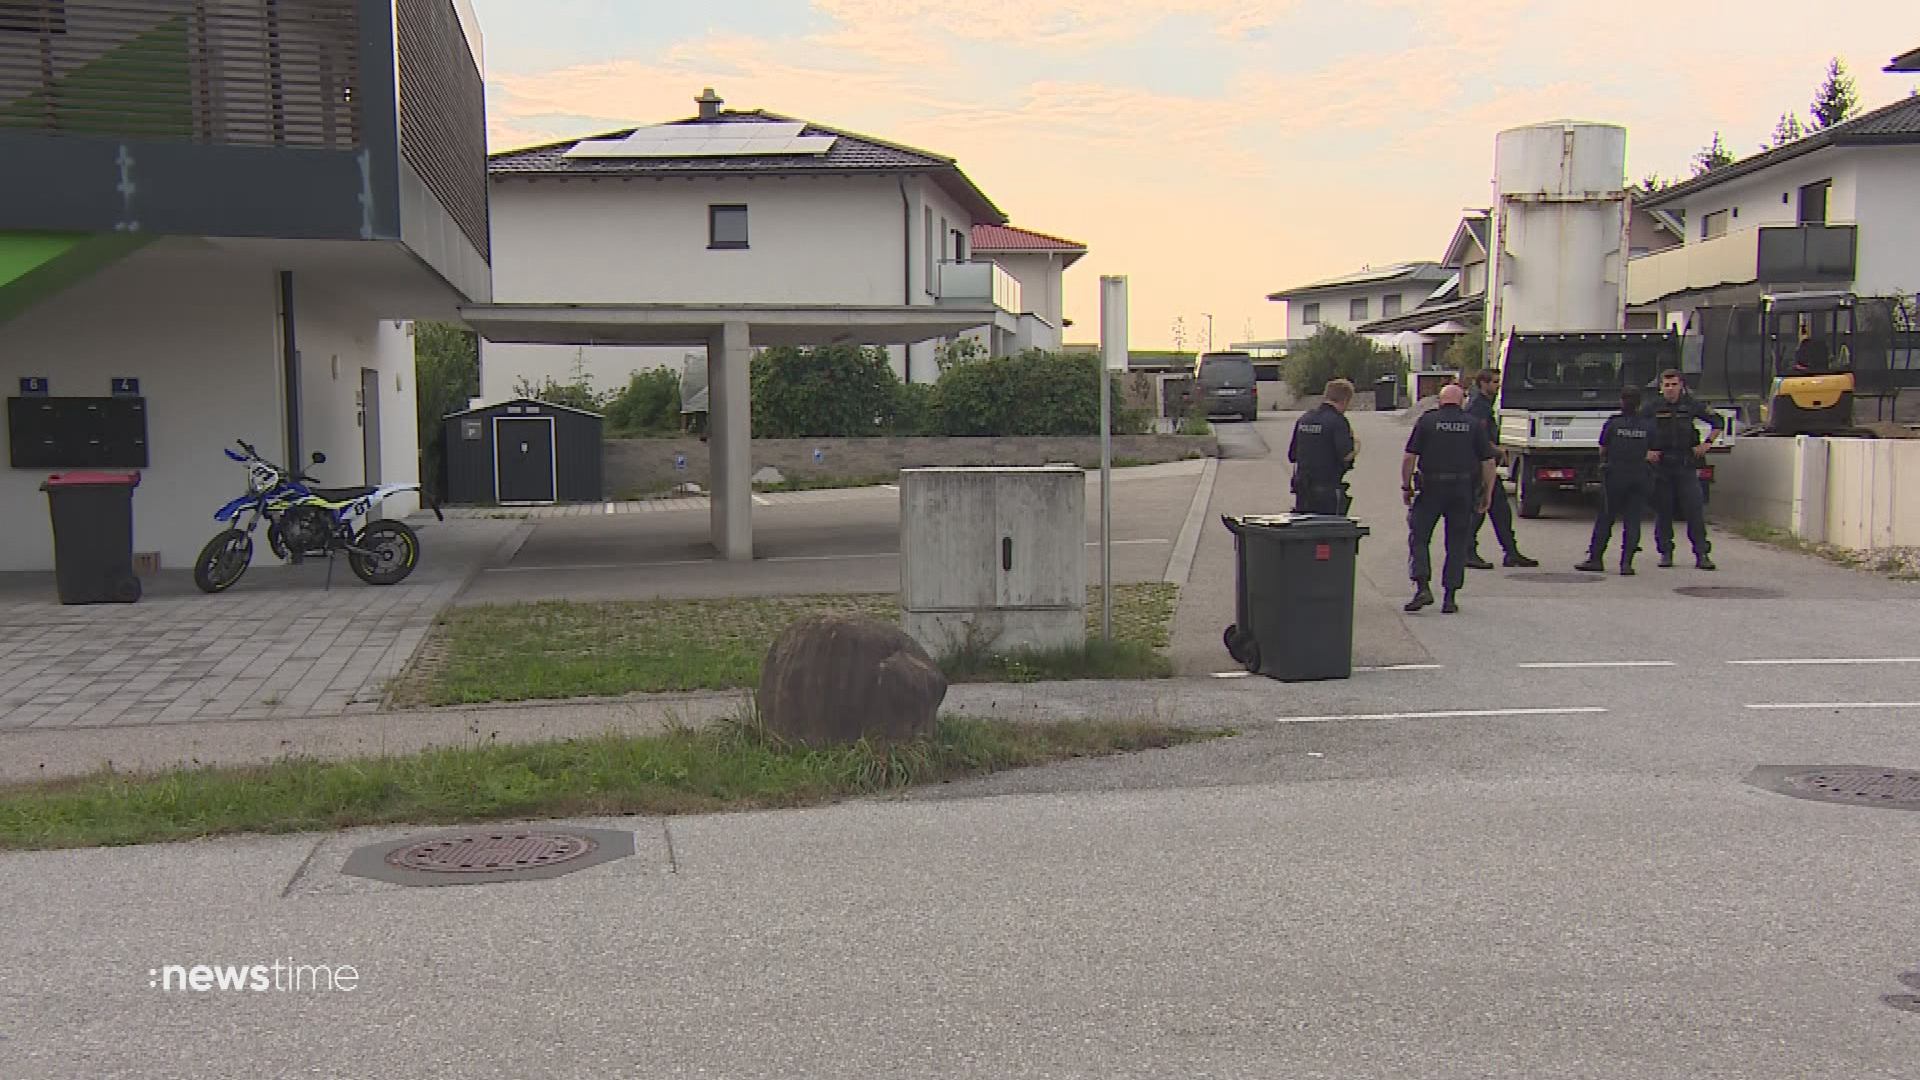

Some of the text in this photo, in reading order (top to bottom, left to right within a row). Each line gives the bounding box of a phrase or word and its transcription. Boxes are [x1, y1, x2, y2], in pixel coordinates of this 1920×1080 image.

[121, 378, 129, 390] 4
[1299, 424, 1322, 434] POLIZEI
[1436, 422, 1470, 432] POLIZEI
[1616, 428, 1647, 438] POLIZEI
